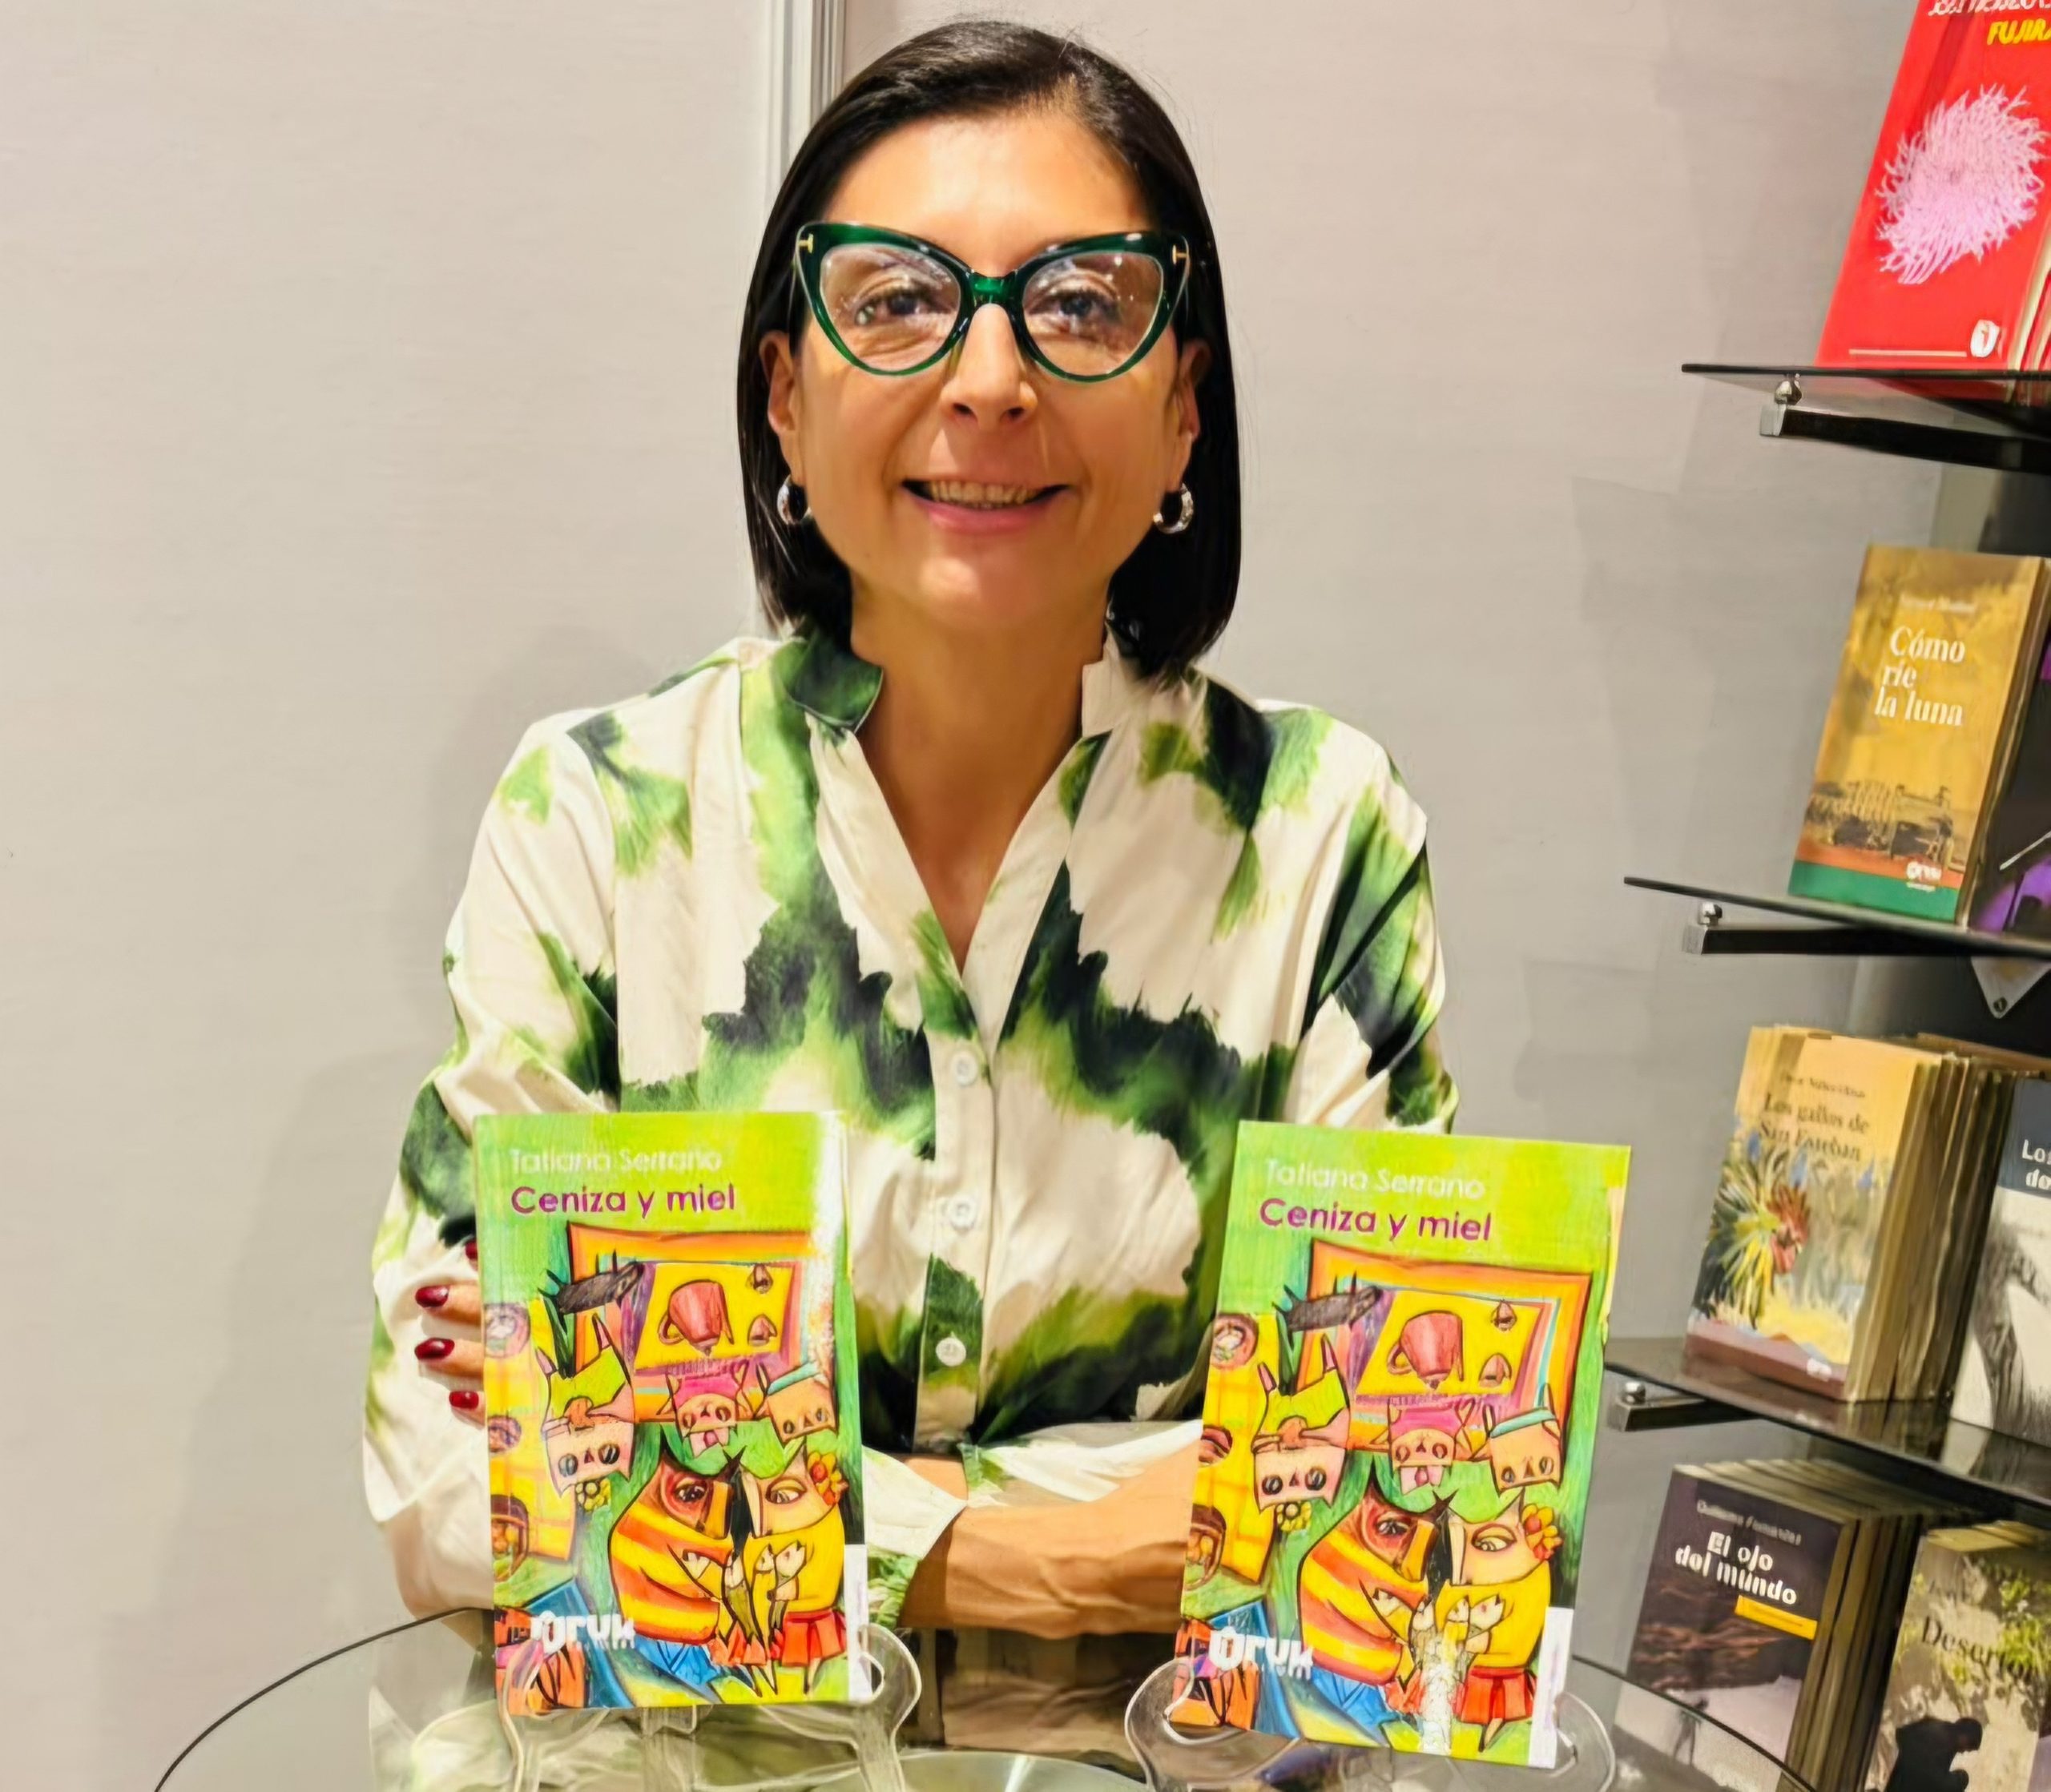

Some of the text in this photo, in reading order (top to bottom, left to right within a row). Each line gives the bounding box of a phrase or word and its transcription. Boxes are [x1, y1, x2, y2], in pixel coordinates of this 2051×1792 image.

[1890, 625, 1966, 664] Cómo
[1875, 685, 1963, 727] la luna
[1848, 1112, 1870, 1134] de
[509, 1148, 611, 1174] Tatiana
[1265, 1158, 1486, 1201] Tatiana Serrano
[510, 1182, 735, 1220] Ceniza y miel
[1259, 1197, 1492, 1242] Ceniza y miel
[1707, 1531, 1774, 1573] El ojo
[1716, 1560, 1797, 1605] mundo
